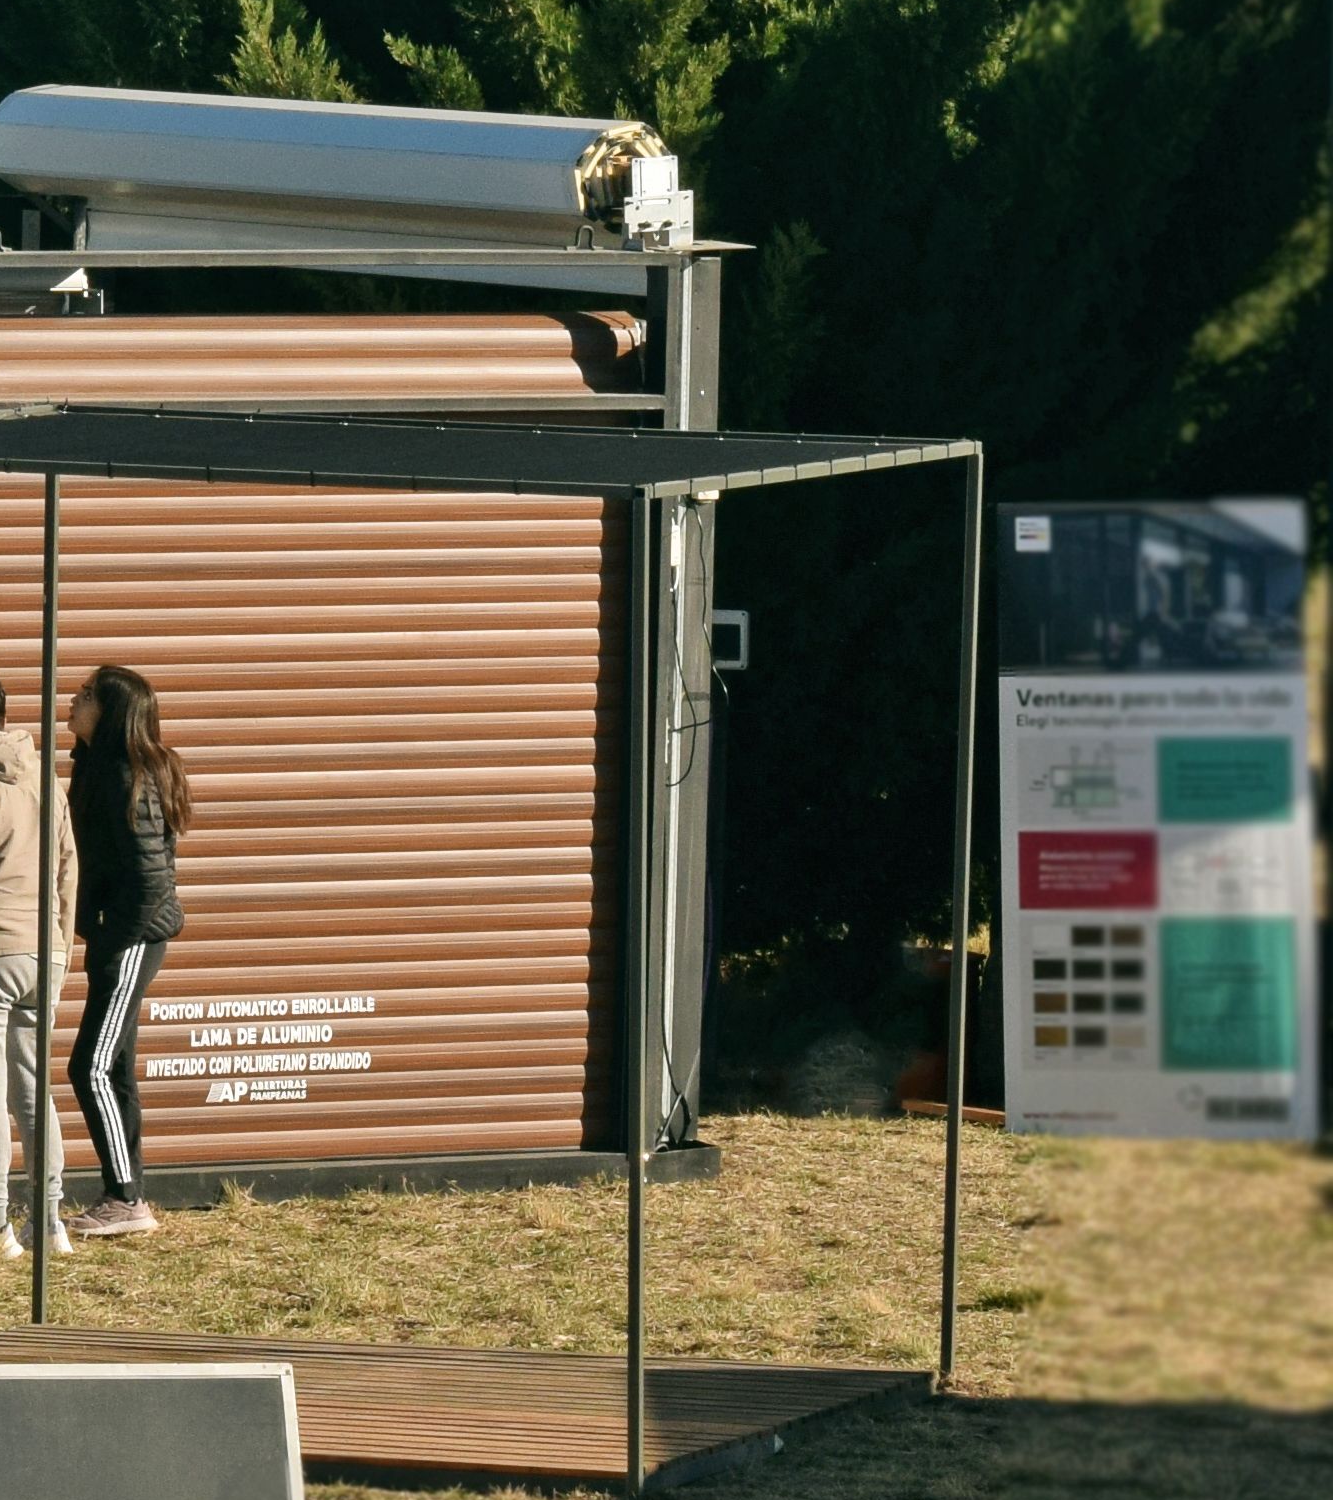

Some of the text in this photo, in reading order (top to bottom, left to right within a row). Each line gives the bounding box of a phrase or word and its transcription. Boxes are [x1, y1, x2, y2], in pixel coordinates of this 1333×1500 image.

[1016, 689, 1116, 708] Ventanas
[150, 996, 375, 1021] PORTON AUTOMATICO ENROLLABLE
[190, 1024, 333, 1047] LAMA DE ALUMINIO
[146, 1052, 371, 1077] INYECTADO CON POLIURETANO EXPANDIDO
[218, 1080, 248, 1103] AP
[250, 1079, 307, 1091] ABERTURAS
